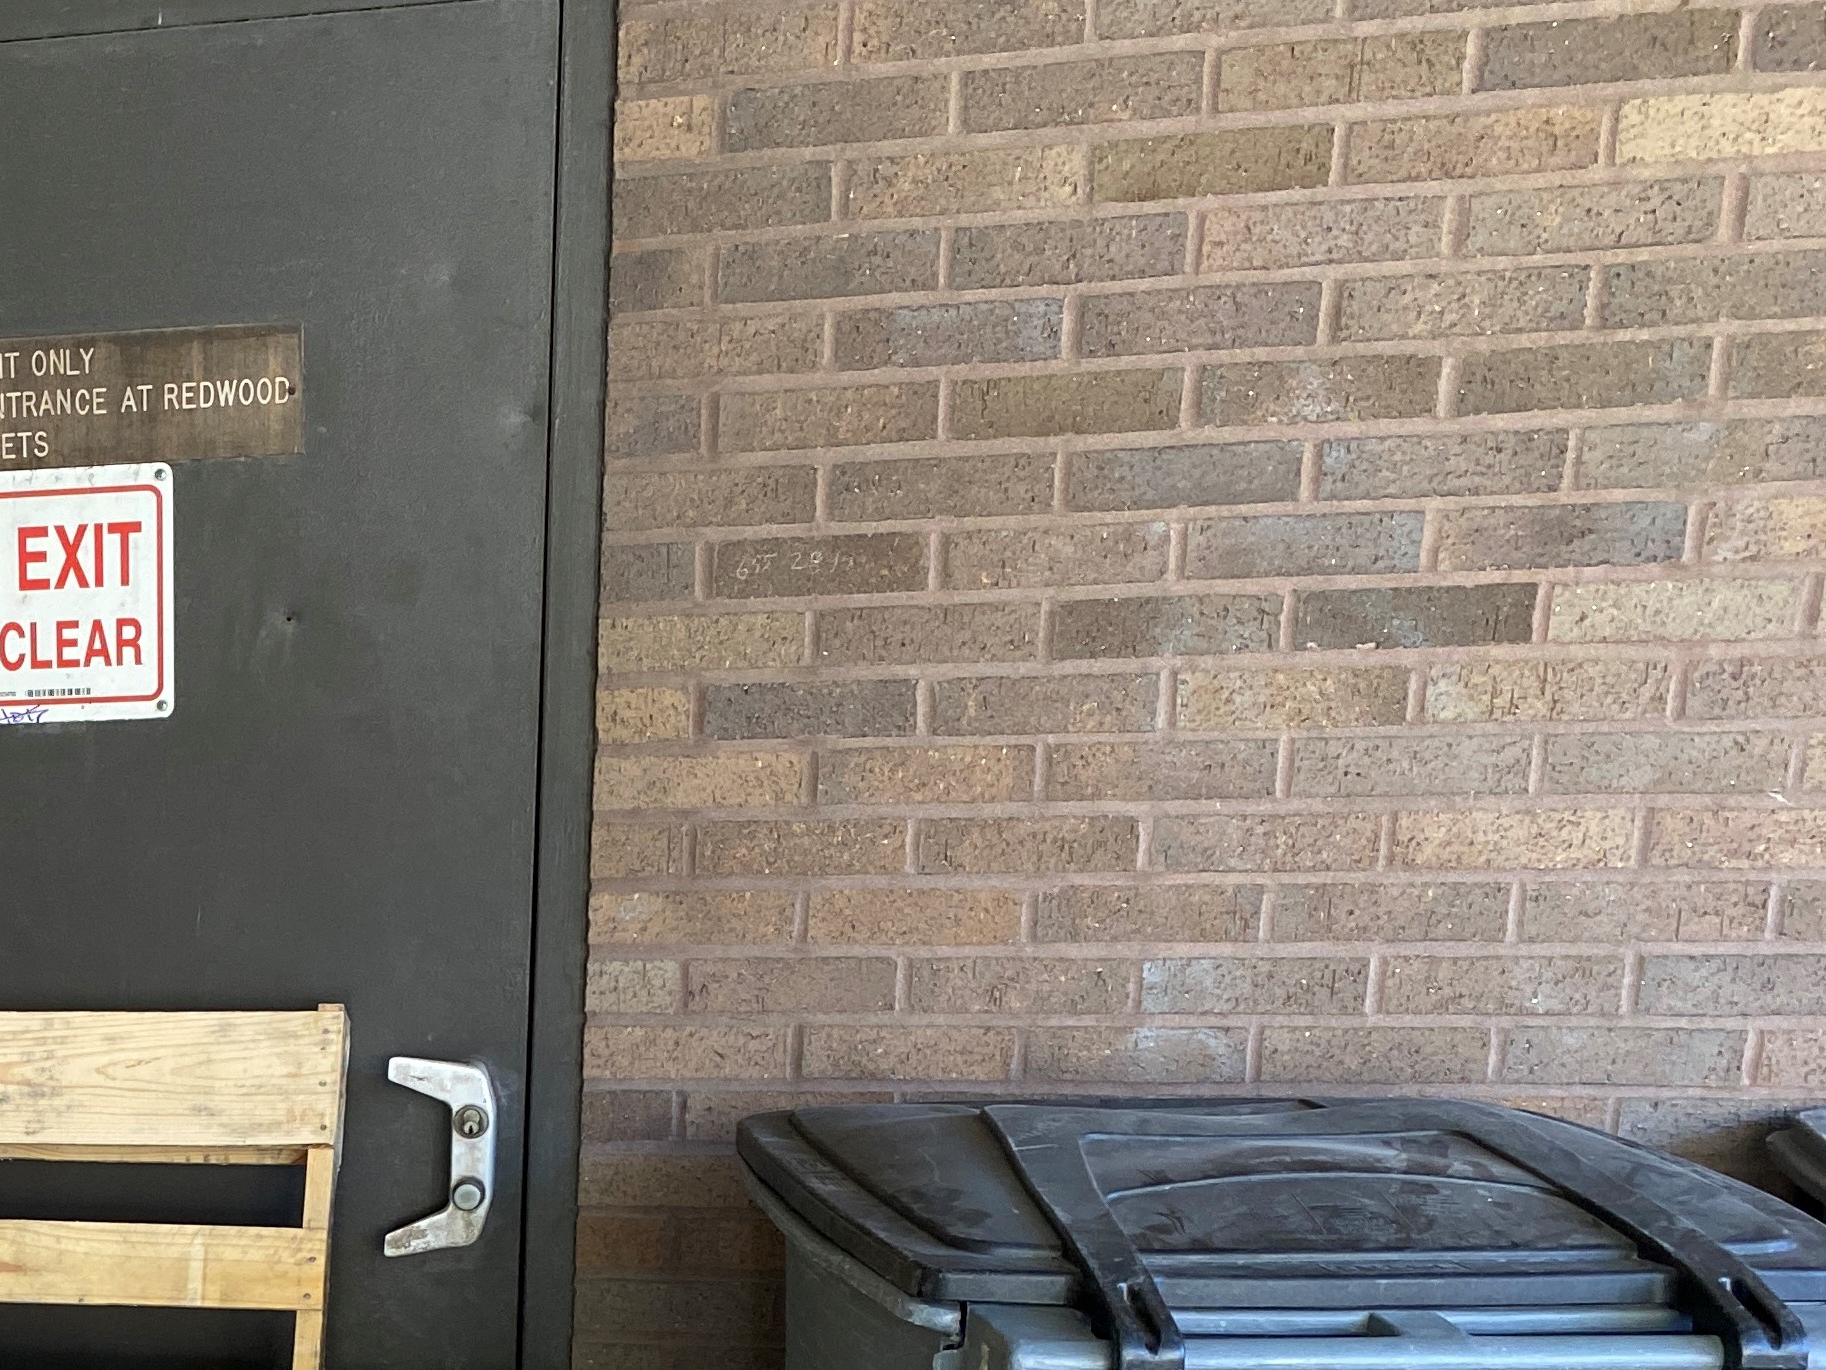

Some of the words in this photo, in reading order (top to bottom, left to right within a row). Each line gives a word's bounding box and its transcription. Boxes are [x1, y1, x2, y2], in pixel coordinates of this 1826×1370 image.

[31, 347, 95, 377] ONLY
[120, 384, 154, 413] AT
[164, 376, 290, 411] REDWOOD
[17, 520, 142, 591] EXIT
